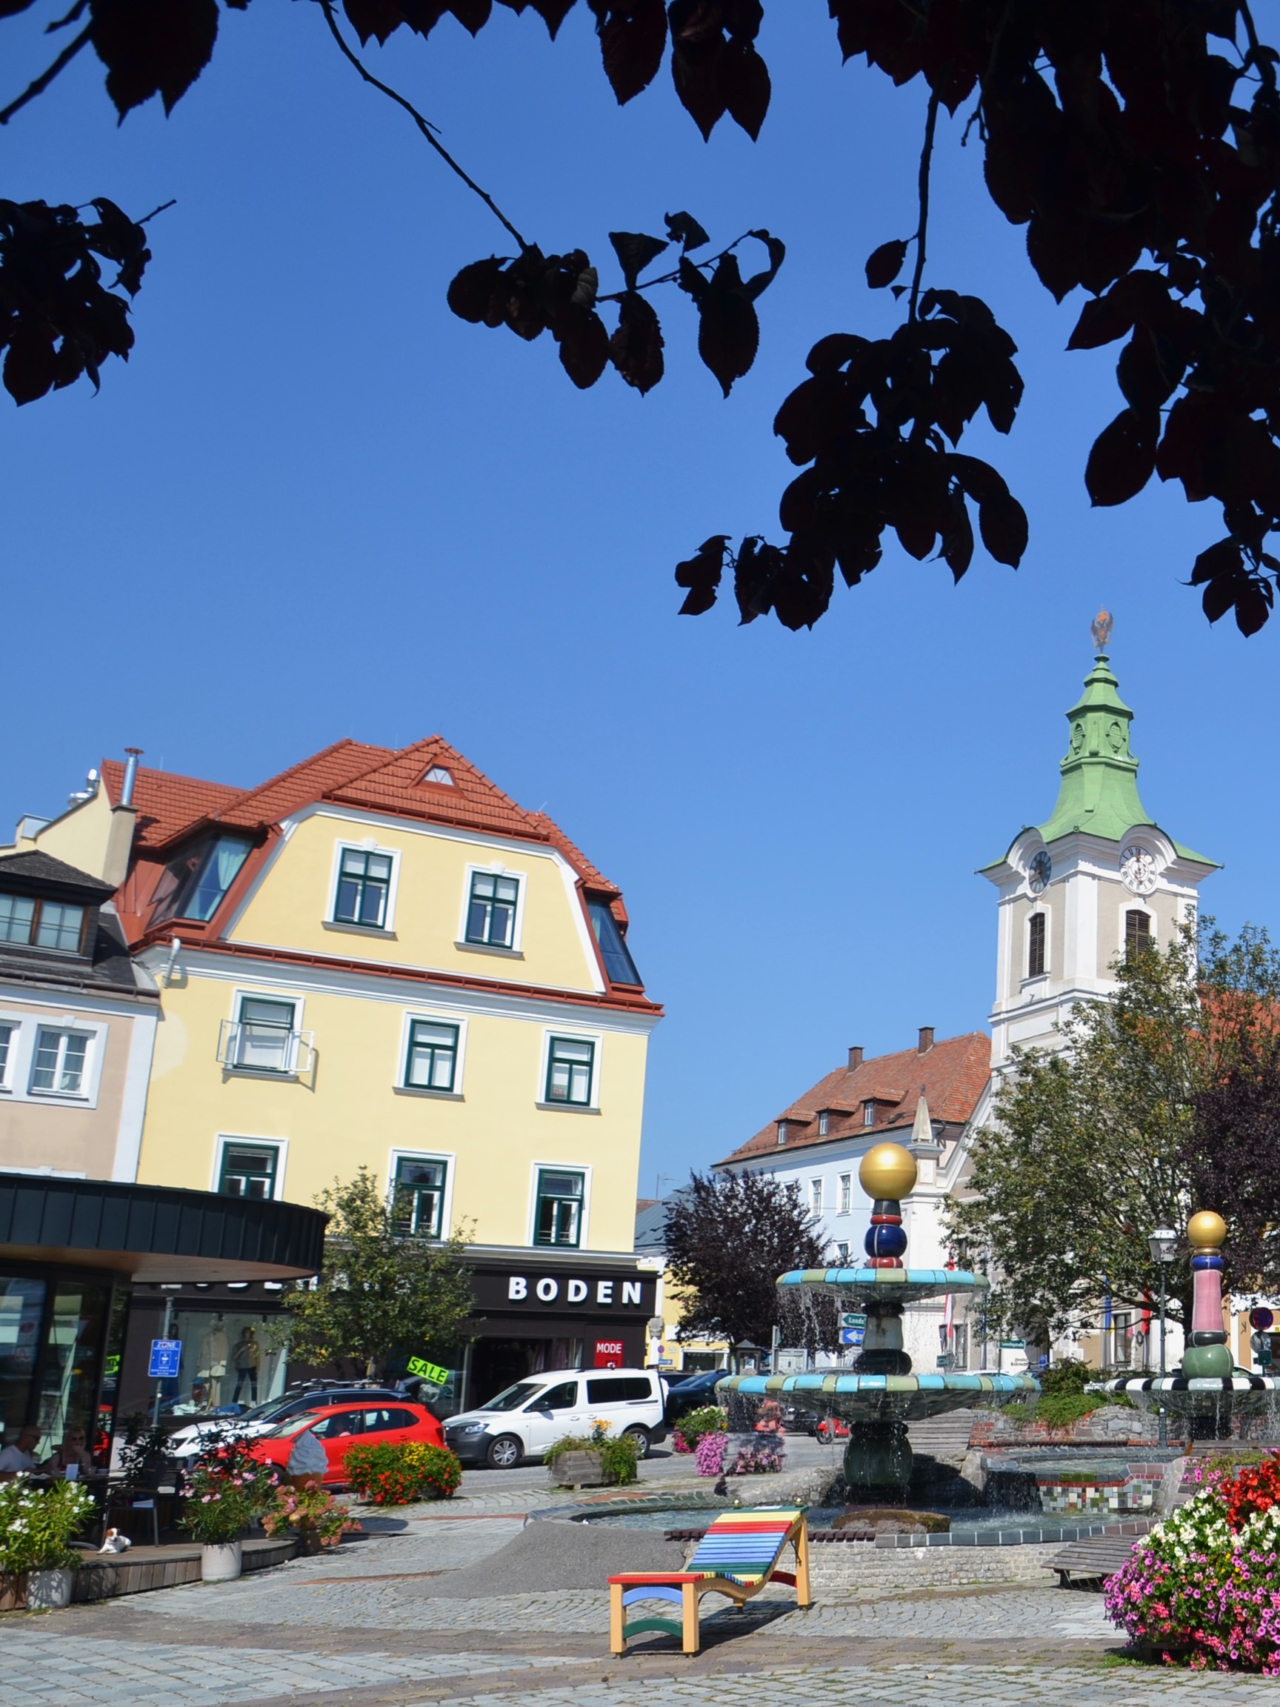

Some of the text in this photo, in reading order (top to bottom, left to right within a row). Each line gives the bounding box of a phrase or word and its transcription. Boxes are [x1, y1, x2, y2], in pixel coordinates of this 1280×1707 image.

[508, 1276, 642, 1304] BODEN
[596, 1343, 622, 1354] MODE
[408, 1359, 448, 1384] SALE
